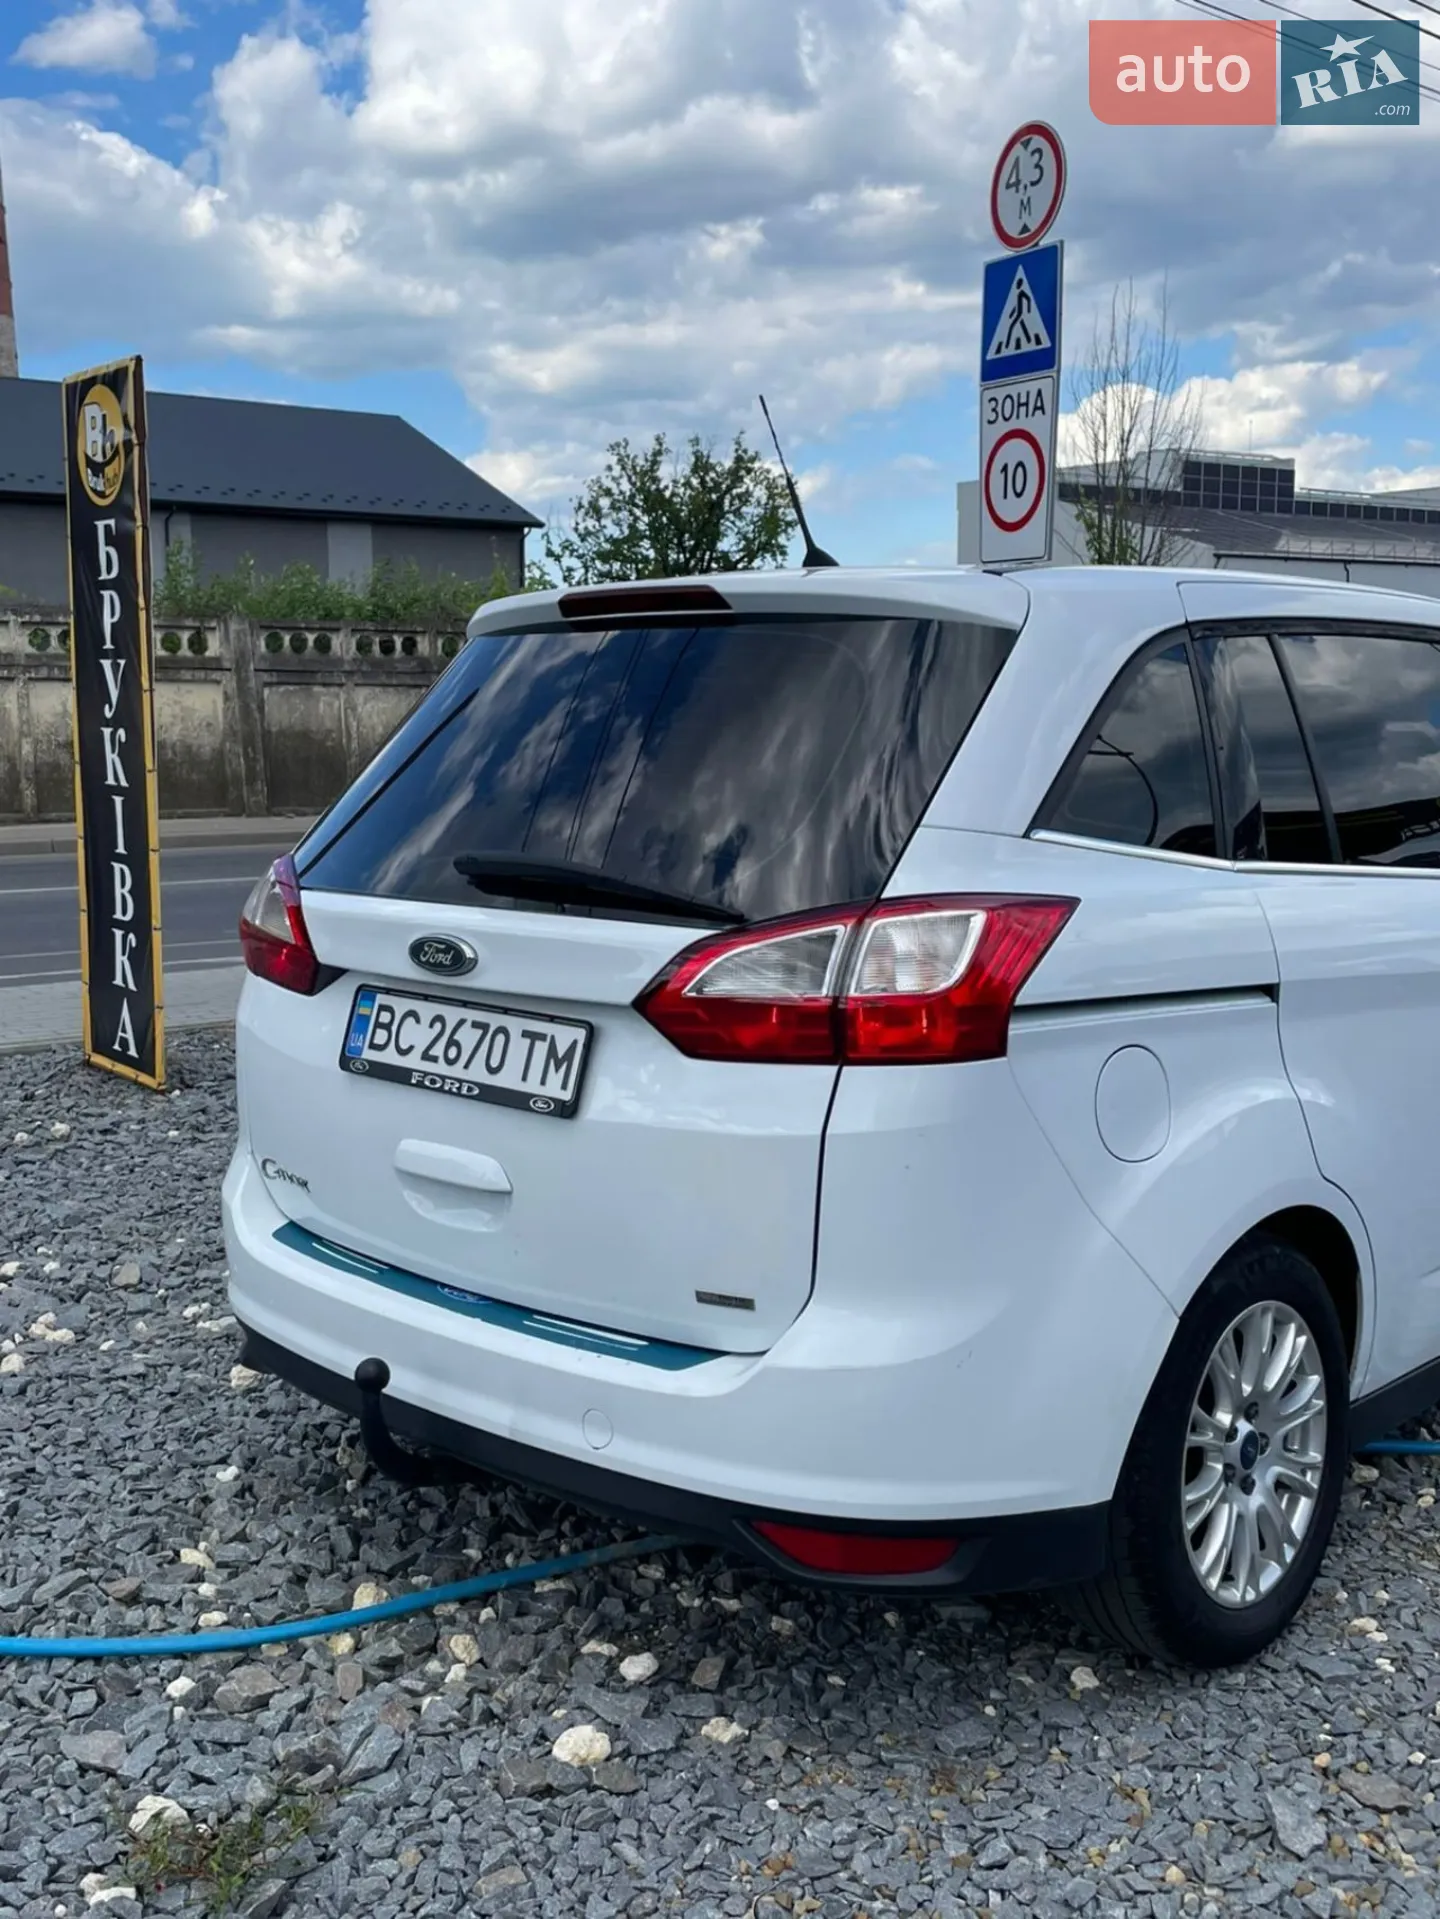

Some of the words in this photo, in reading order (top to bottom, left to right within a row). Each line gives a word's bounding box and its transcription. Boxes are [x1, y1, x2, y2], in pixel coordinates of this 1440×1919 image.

[1005, 147, 1045, 196] 4,3
[987, 387, 1046, 425] ЗОНА
[1000, 460, 1028, 500] 10
[94, 519, 140, 1060] БРУКІВКА
[420, 941, 455, 965] Ford
[350, 1032, 364, 1047] UA
[367, 1003, 421, 1056] BC
[420, 1014, 511, 1076] 2670
[520, 1029, 579, 1091] TM
[410, 1071, 480, 1097] FORD
